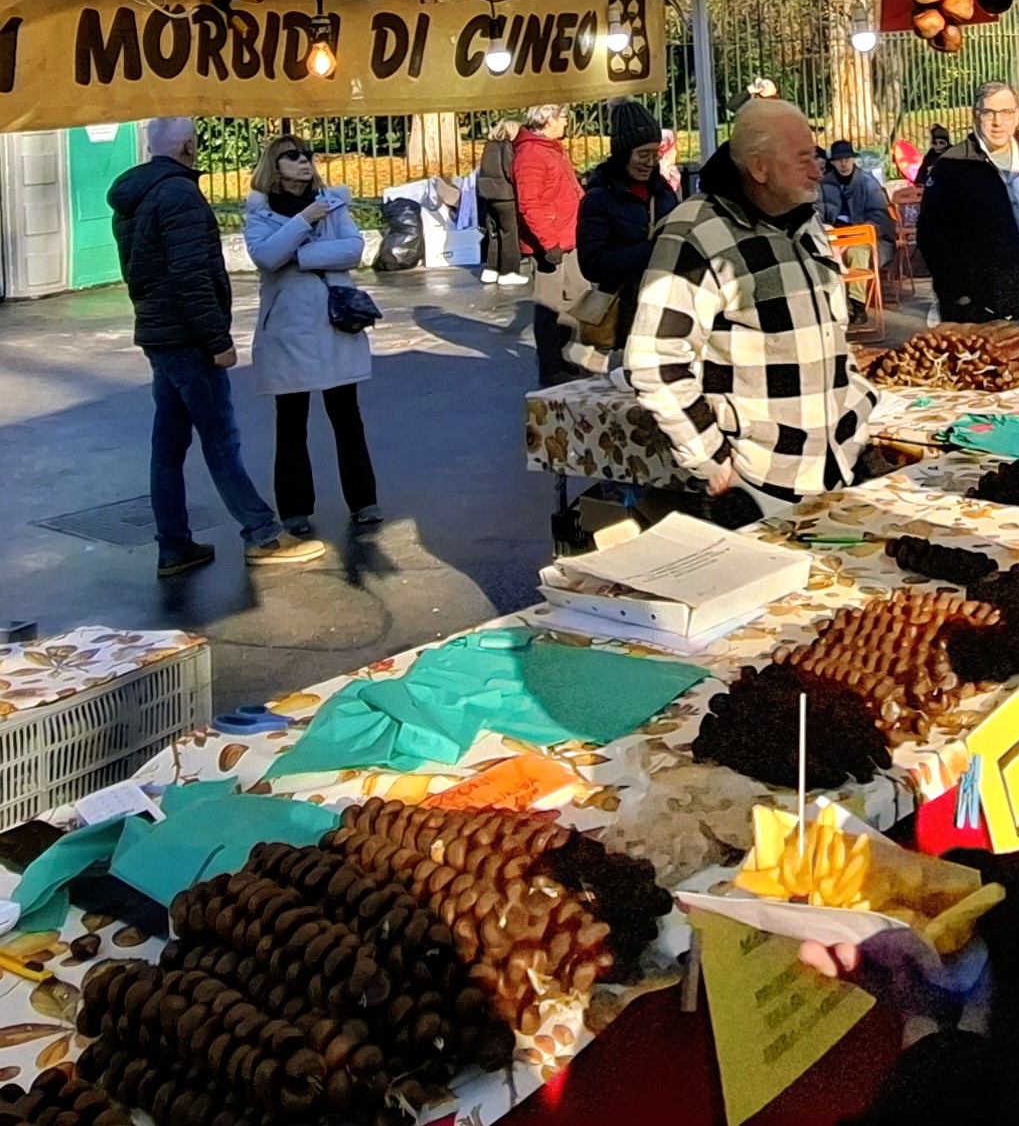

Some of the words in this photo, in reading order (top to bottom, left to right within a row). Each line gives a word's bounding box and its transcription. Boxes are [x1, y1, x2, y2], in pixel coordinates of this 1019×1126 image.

[74, 2, 341, 87] MORBIDI
[370, 11, 430, 81] DI
[454, 10, 599, 79] CUNEO
